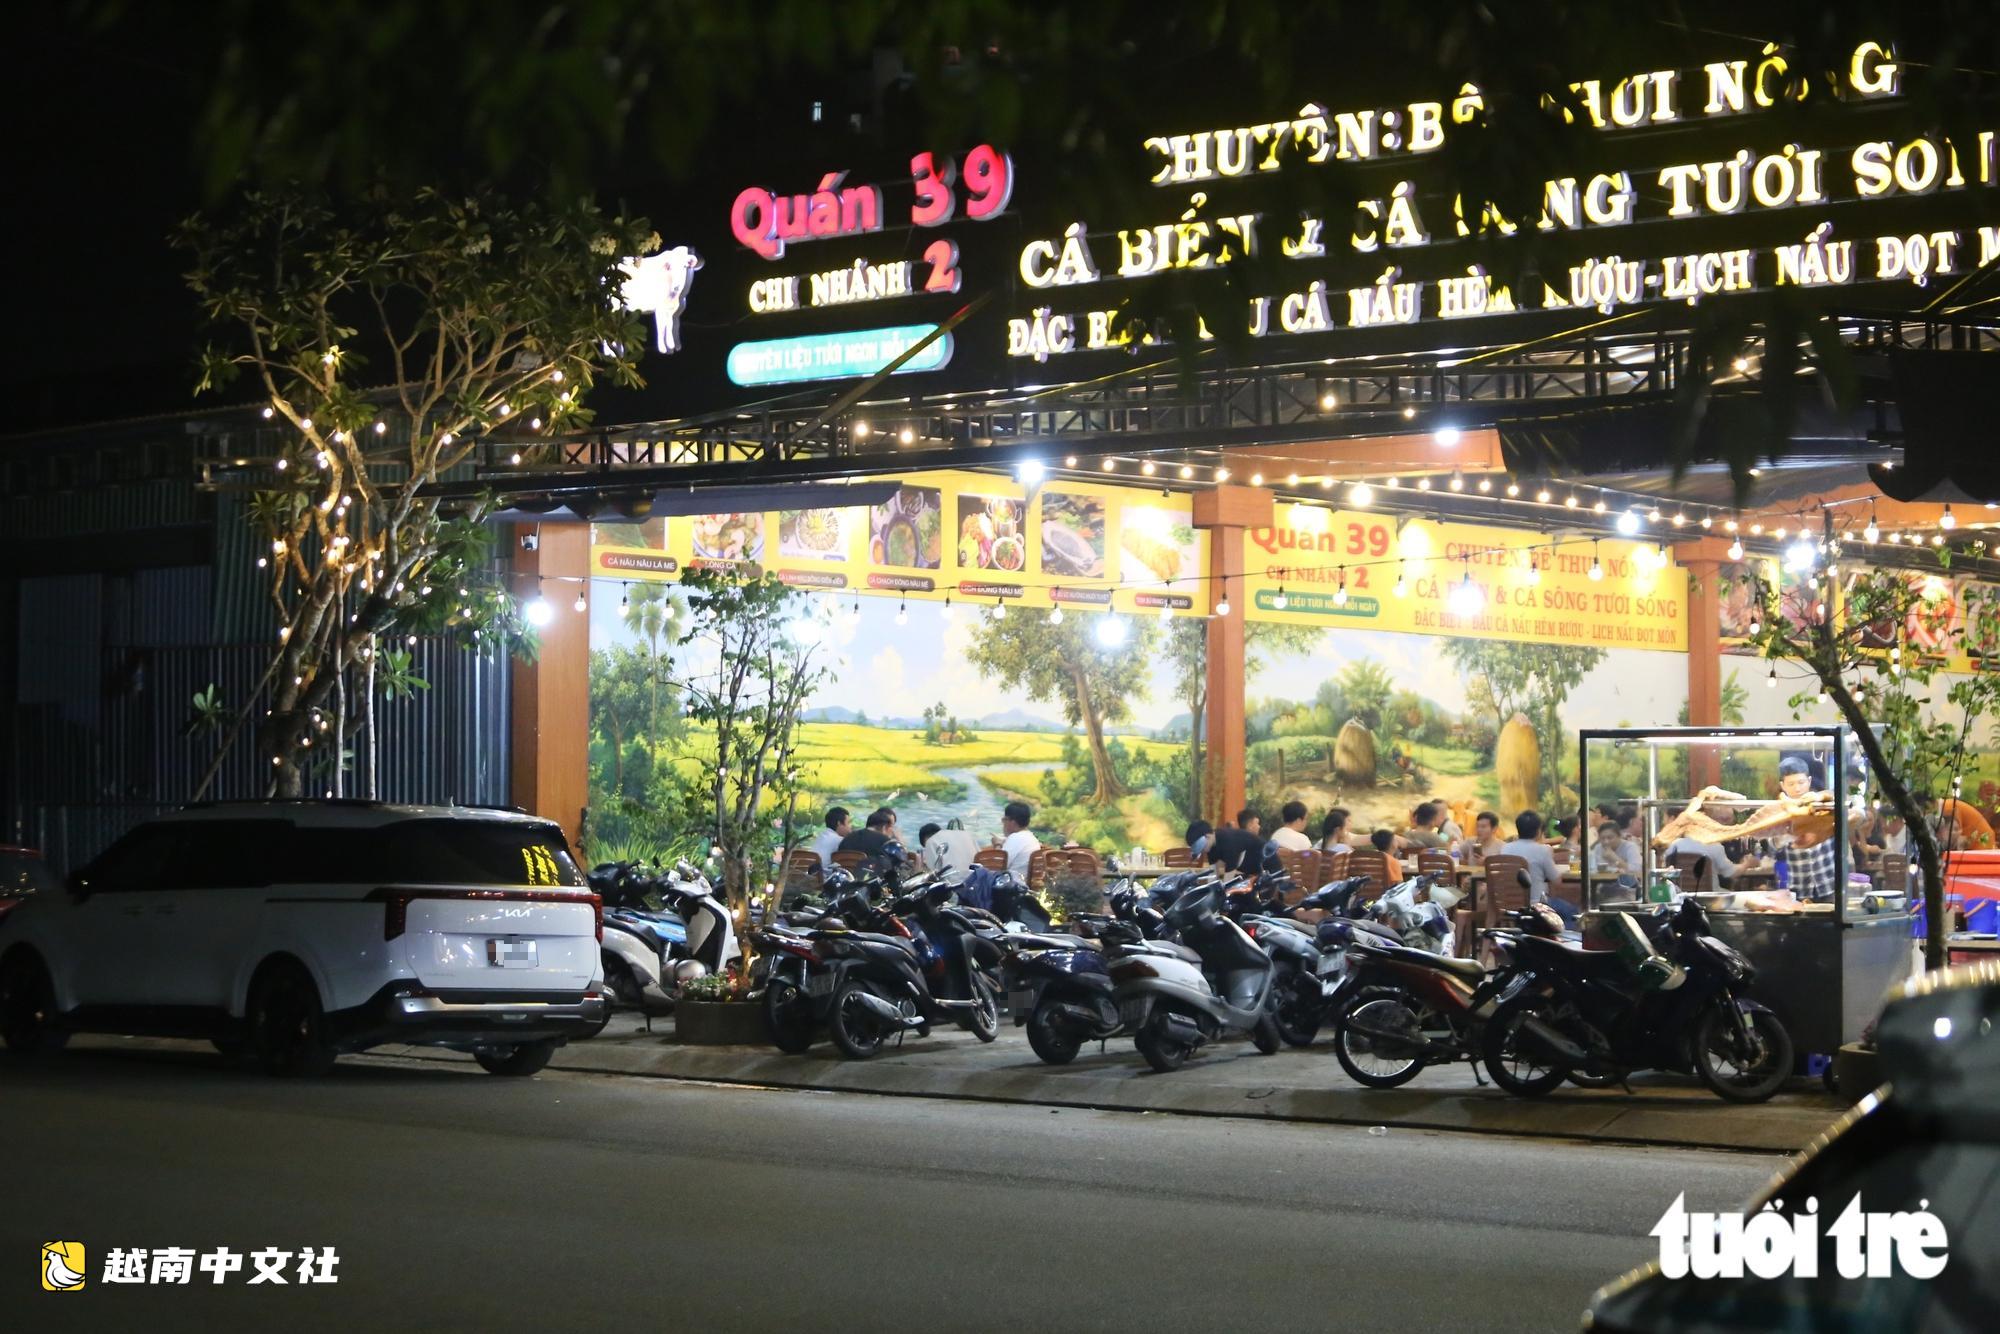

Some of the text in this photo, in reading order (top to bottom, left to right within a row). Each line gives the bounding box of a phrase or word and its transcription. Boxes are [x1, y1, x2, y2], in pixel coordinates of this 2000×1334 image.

[731, 143, 1012, 260] Quán 39
[1020, 222, 1093, 287] CÁ
[1658, 143, 1822, 218] TƯƠI
[748, 239, 959, 313] CHI NHÁNH 2
[1008, 307, 1068, 361] ĐẶC
[1281, 280, 1327, 331] CÁ
[1348, 266, 1416, 328] NẤU
[1776, 221, 1852, 287] NẤU
[1876, 233, 1957, 288] ĐỌT
[1346, 522, 1390, 557] 39
[1354, 565, 1370, 589] 2
[1416, 574, 1440, 599] CÁ
[1495, 585, 1508, 605] &
[1514, 584, 1538, 608] CÁ
[1543, 586, 1588, 612] SÔNG
[1593, 592, 1631, 615] TƯƠI
[1636, 590, 1678, 618] SỐNG
